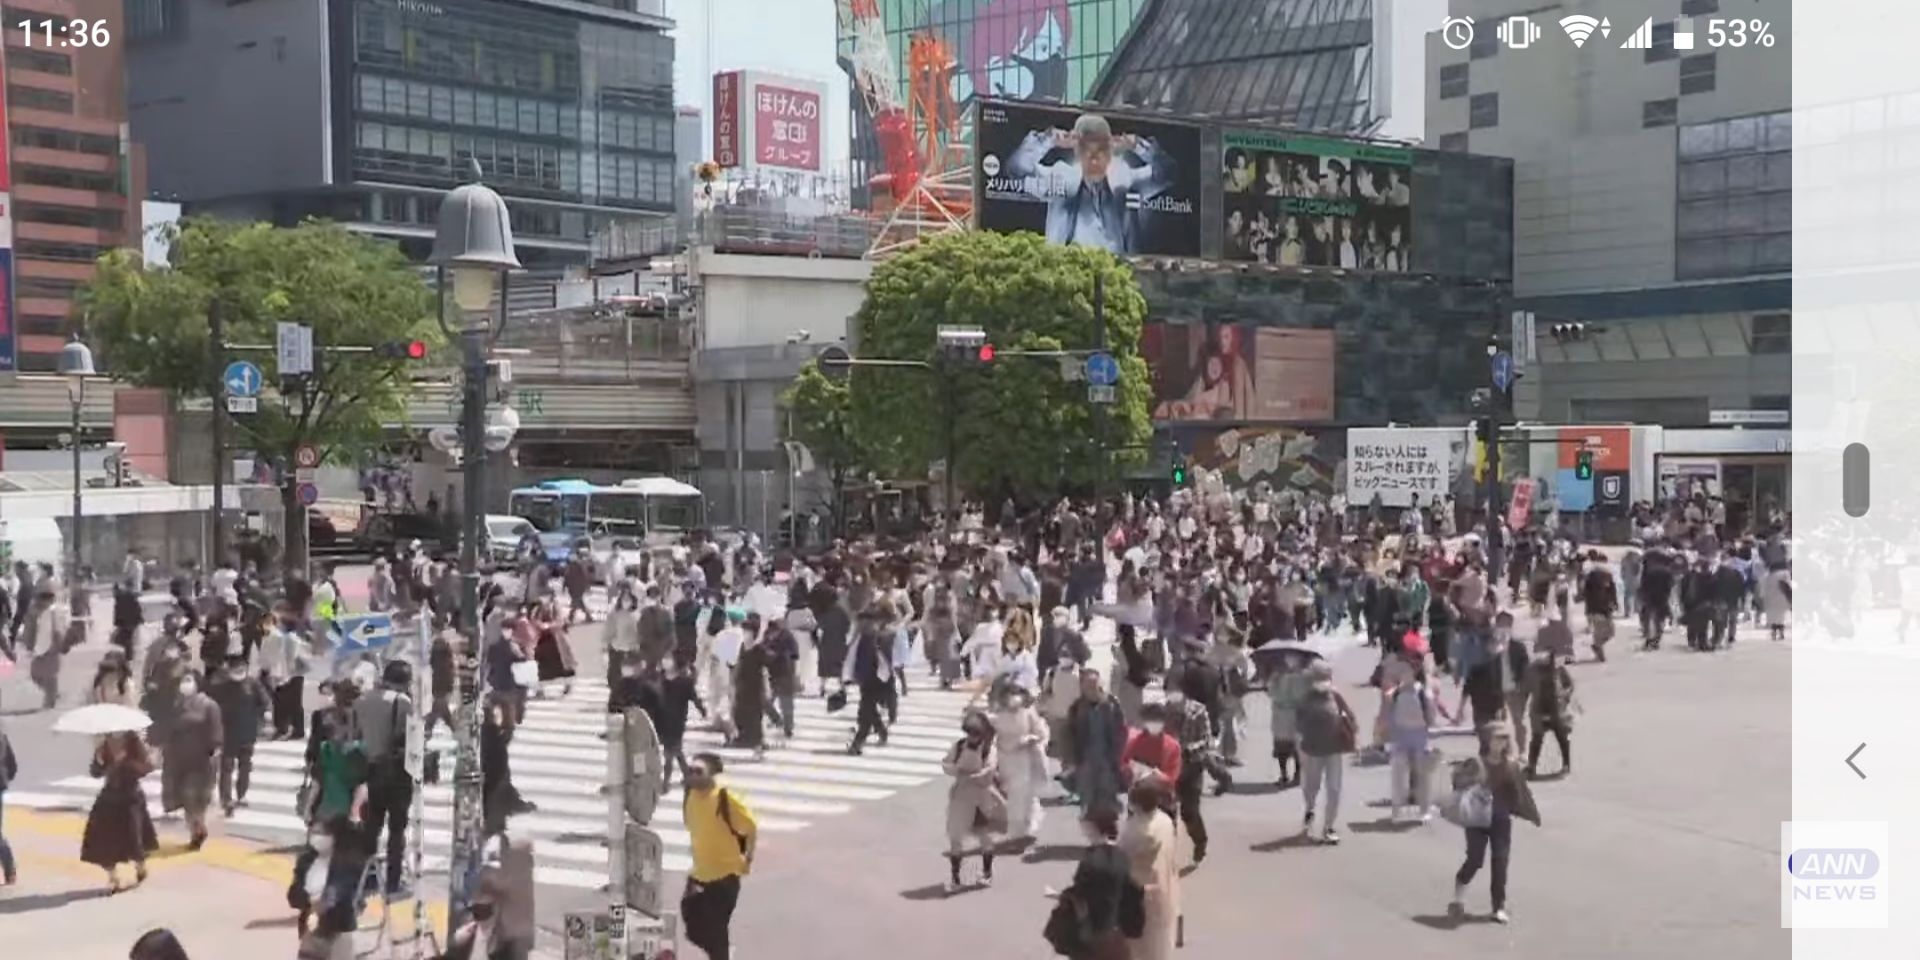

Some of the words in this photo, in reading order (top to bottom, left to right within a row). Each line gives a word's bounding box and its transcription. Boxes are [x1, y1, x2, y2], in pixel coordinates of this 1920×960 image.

[757, 92, 817, 119] ほけんの
[1143, 195, 1193, 213] SoftBank
[1354, 445, 1428, 458] 知らない人には
